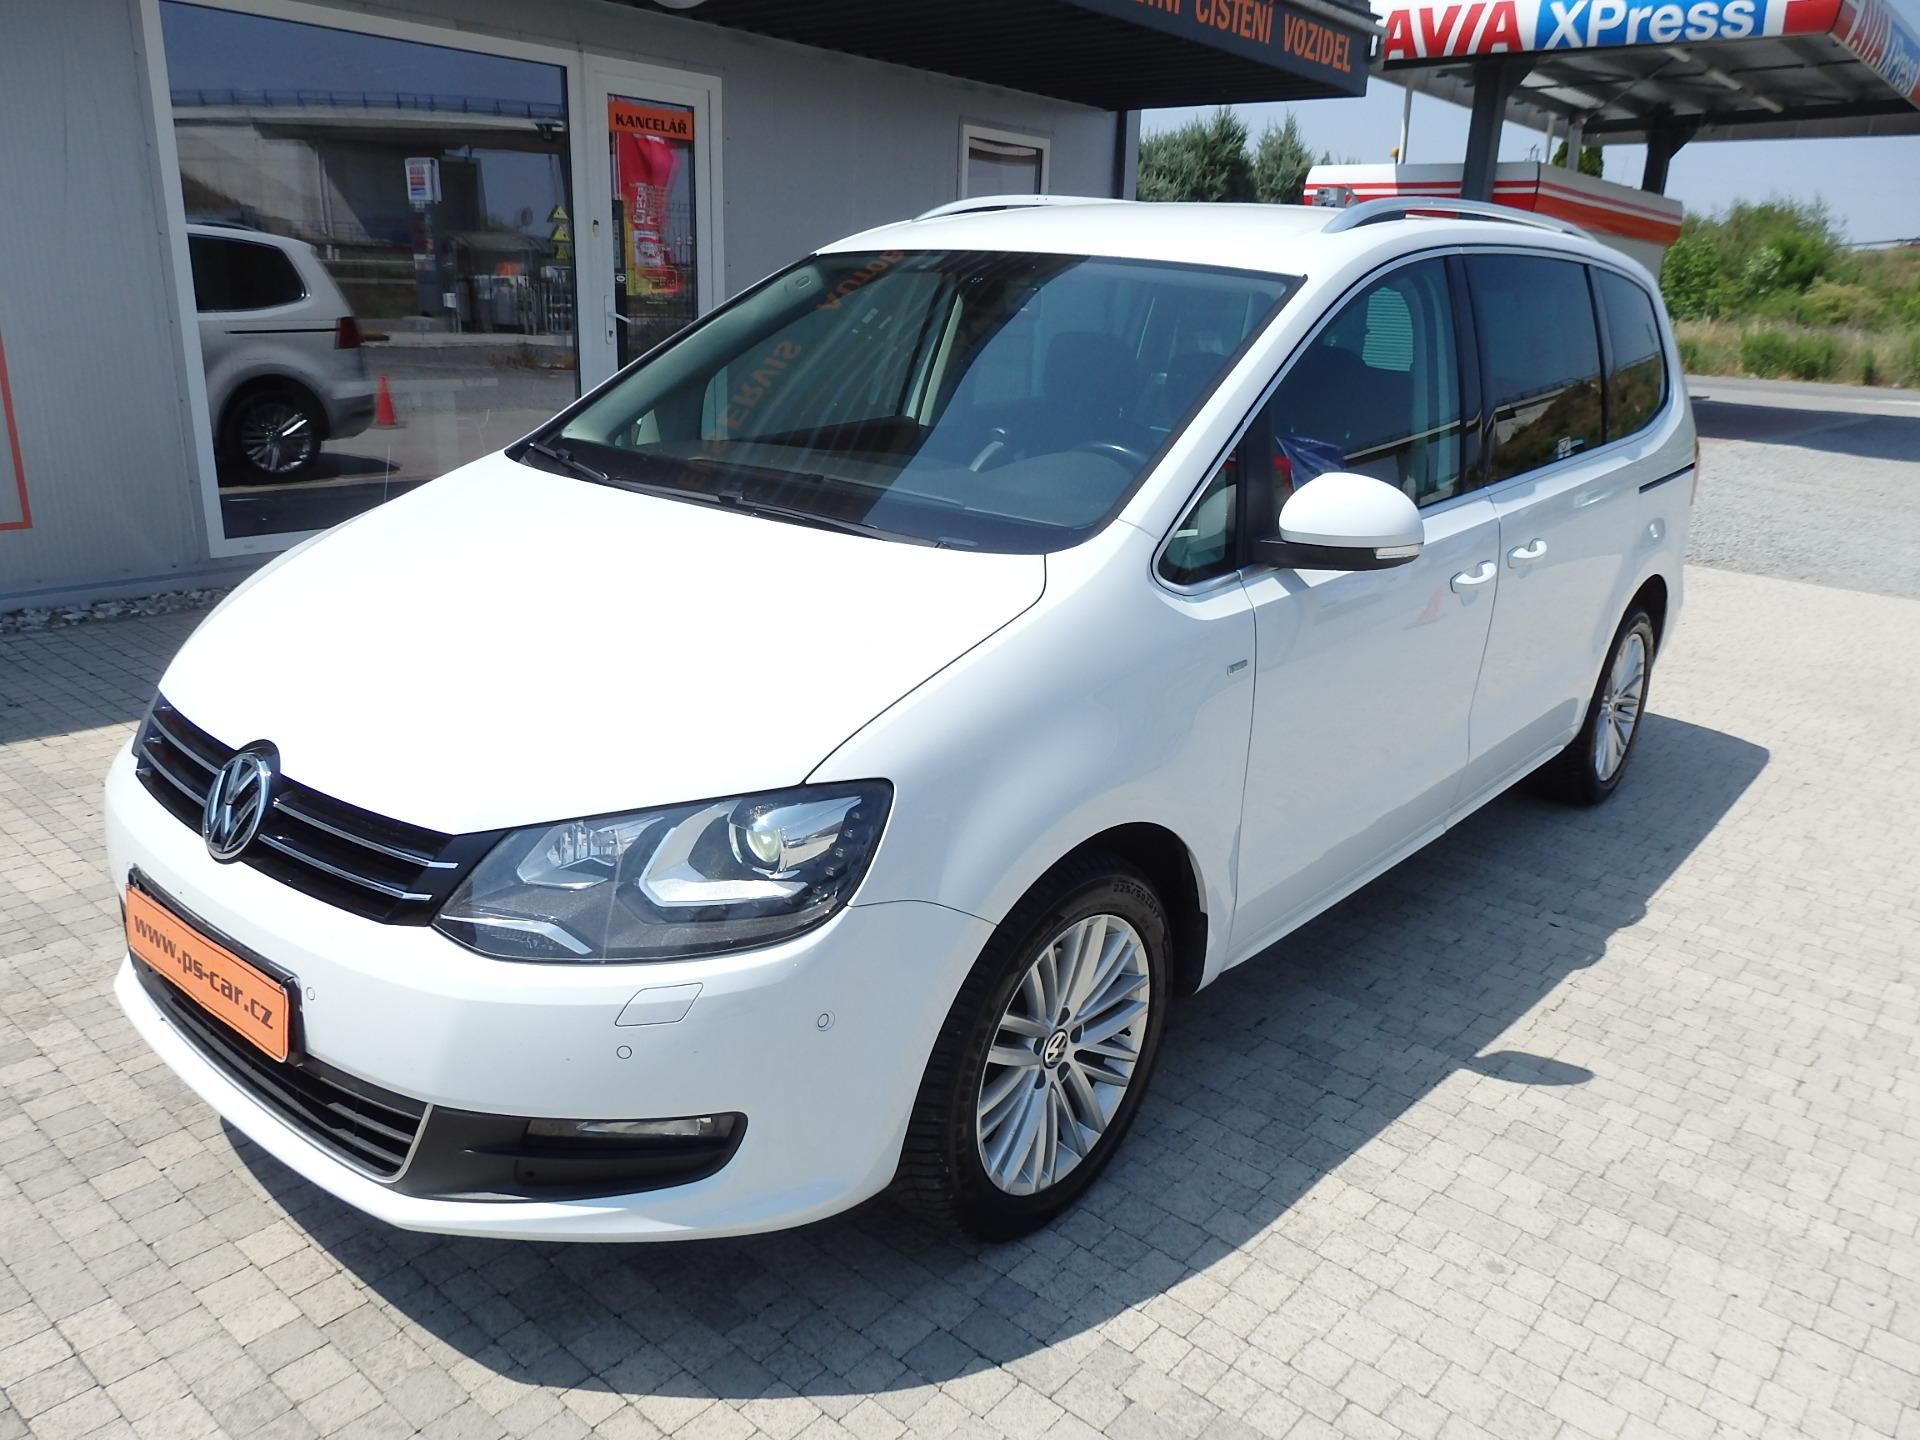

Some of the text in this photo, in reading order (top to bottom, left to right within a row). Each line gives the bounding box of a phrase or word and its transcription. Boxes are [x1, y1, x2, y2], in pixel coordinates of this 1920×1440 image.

[1284, 13, 1351, 72] VOZIDEL
[1383, 0, 1755, 60] AVIA XPress
[615, 112, 687, 134] KANCELÁŘ
[134, 914, 274, 1031] www.ps-car.cz
